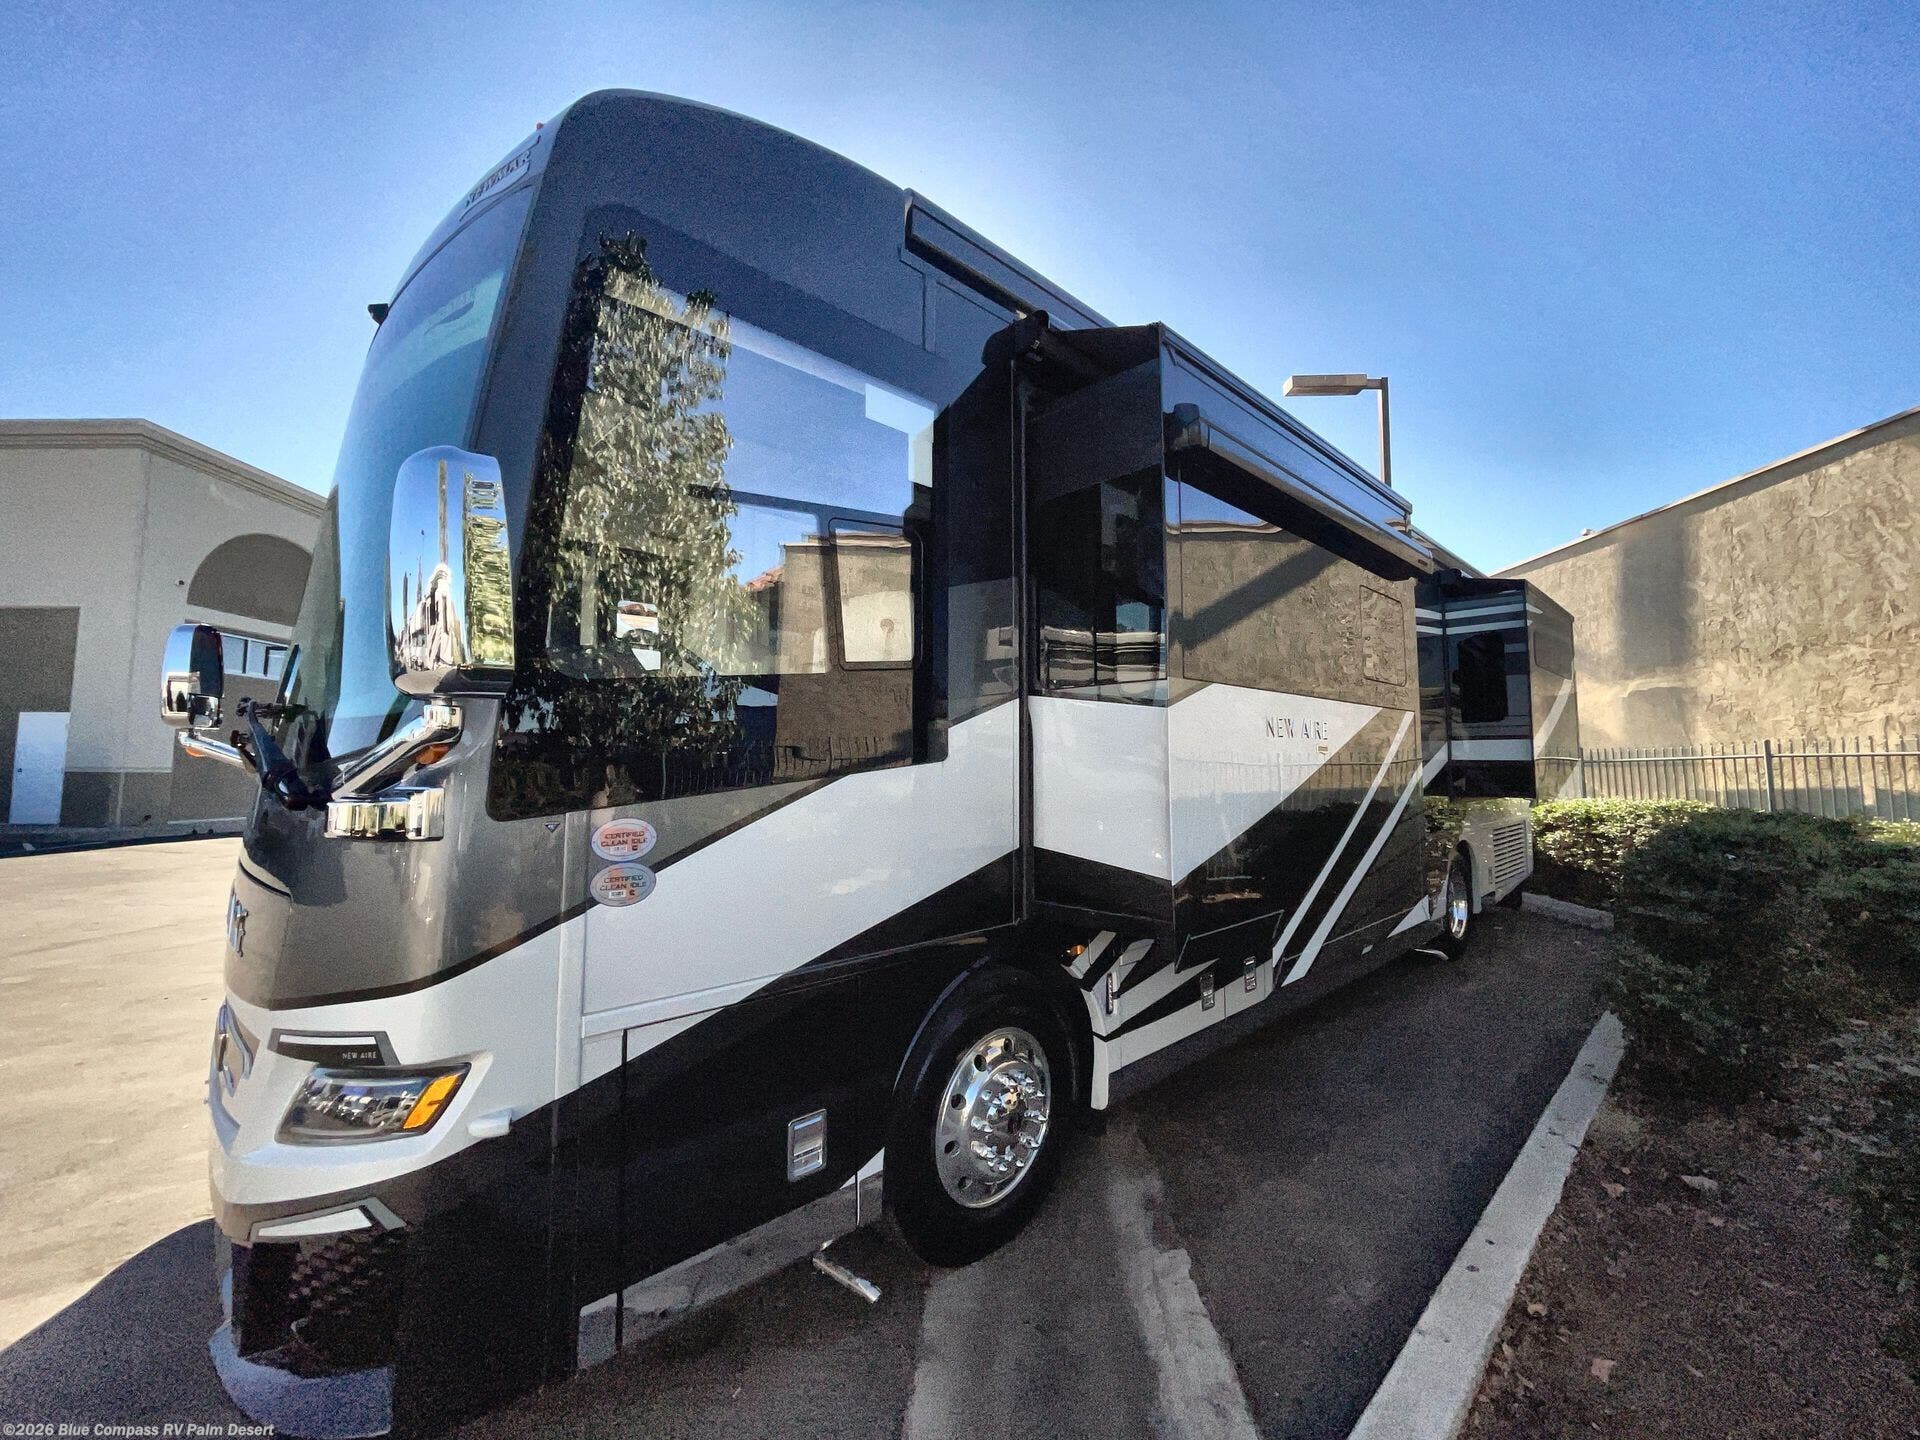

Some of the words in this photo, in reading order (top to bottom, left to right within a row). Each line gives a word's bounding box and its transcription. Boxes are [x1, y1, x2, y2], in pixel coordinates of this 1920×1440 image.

[1265, 717, 1295, 738] NEW
[605, 831, 645, 839] CERTIFIED
[601, 839, 628, 847] CLEAN
[604, 875, 643, 883] CERTIFIED
[600, 883, 627, 891] CLEAN
[342, 1051, 358, 1060] NEW
[360, 1051, 377, 1059] AIRE
